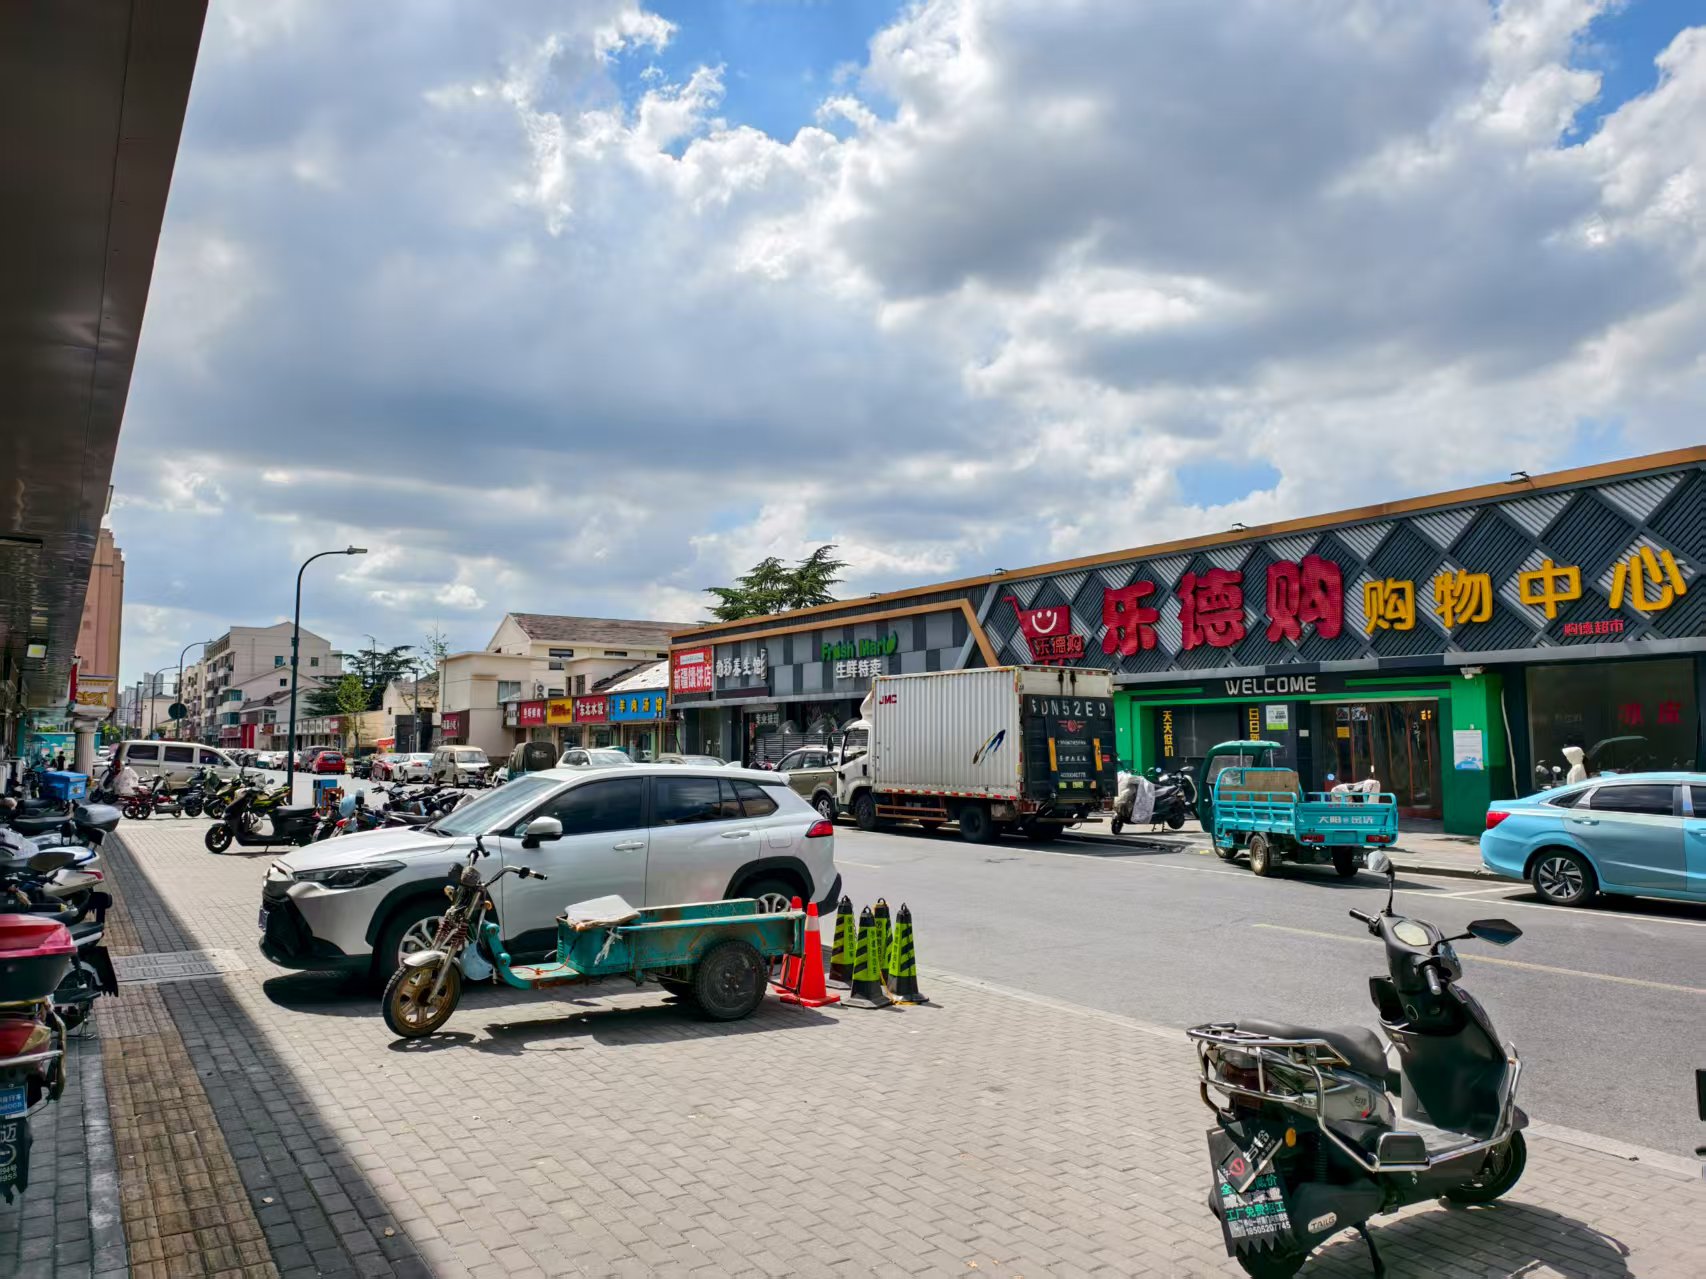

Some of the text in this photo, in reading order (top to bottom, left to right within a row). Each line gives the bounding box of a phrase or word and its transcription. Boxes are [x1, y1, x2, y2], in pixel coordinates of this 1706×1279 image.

[1102, 545, 1688, 656] 乐德购 购物中心
[836, 659, 882, 678] 生鲜特卖
[1225, 676, 1317, 695] WELCOME
[879, 695, 897, 704] JMC
[1163, 710, 1174, 757] 天天低价
[0, 1093, 22, 1103] 自行车
[1225, 1201, 1286, 1221] 工厂免费招工
[1310, 1215, 1336, 1231] TAILG
